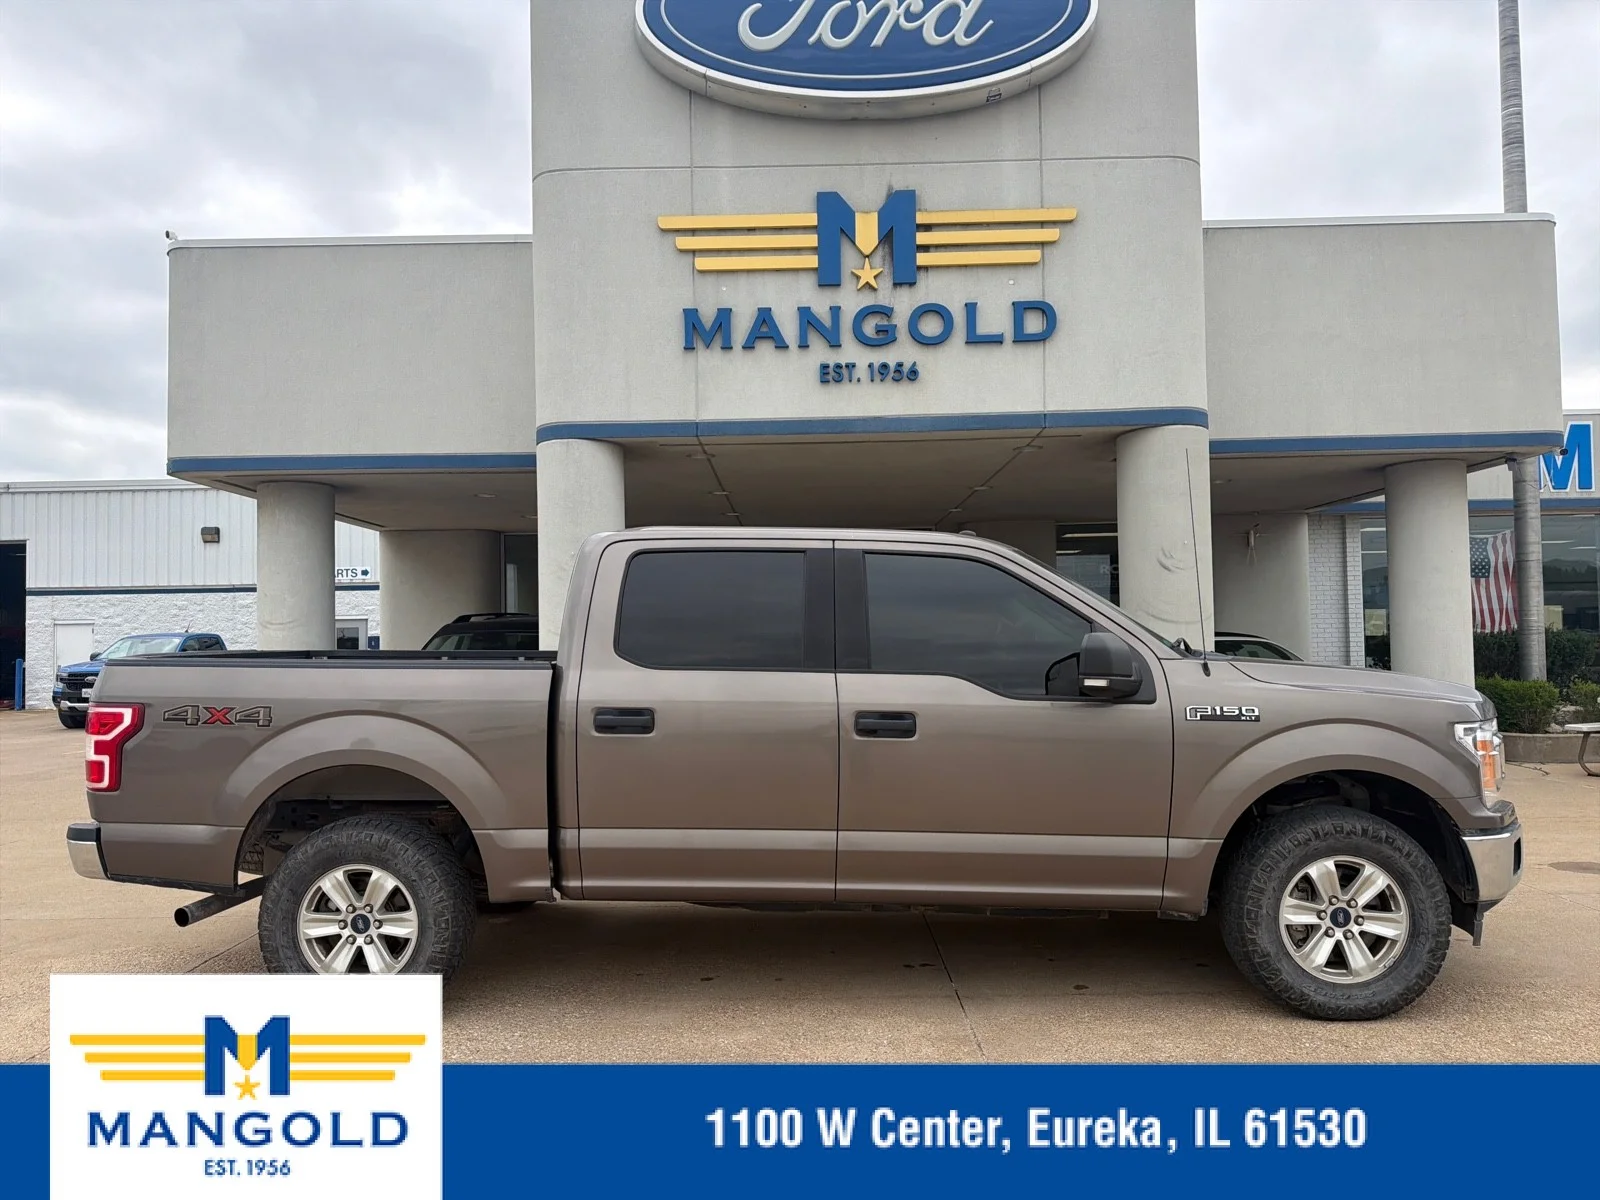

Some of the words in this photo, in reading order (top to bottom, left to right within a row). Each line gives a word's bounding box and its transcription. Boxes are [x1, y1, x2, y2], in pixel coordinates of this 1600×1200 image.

[682, 300, 1058, 350] MANGOLD
[819, 361, 861, 383] EST.
[869, 361, 920, 382] 1956
[335, 568, 358, 578] RTS
[1185, 705, 1260, 720] F150
